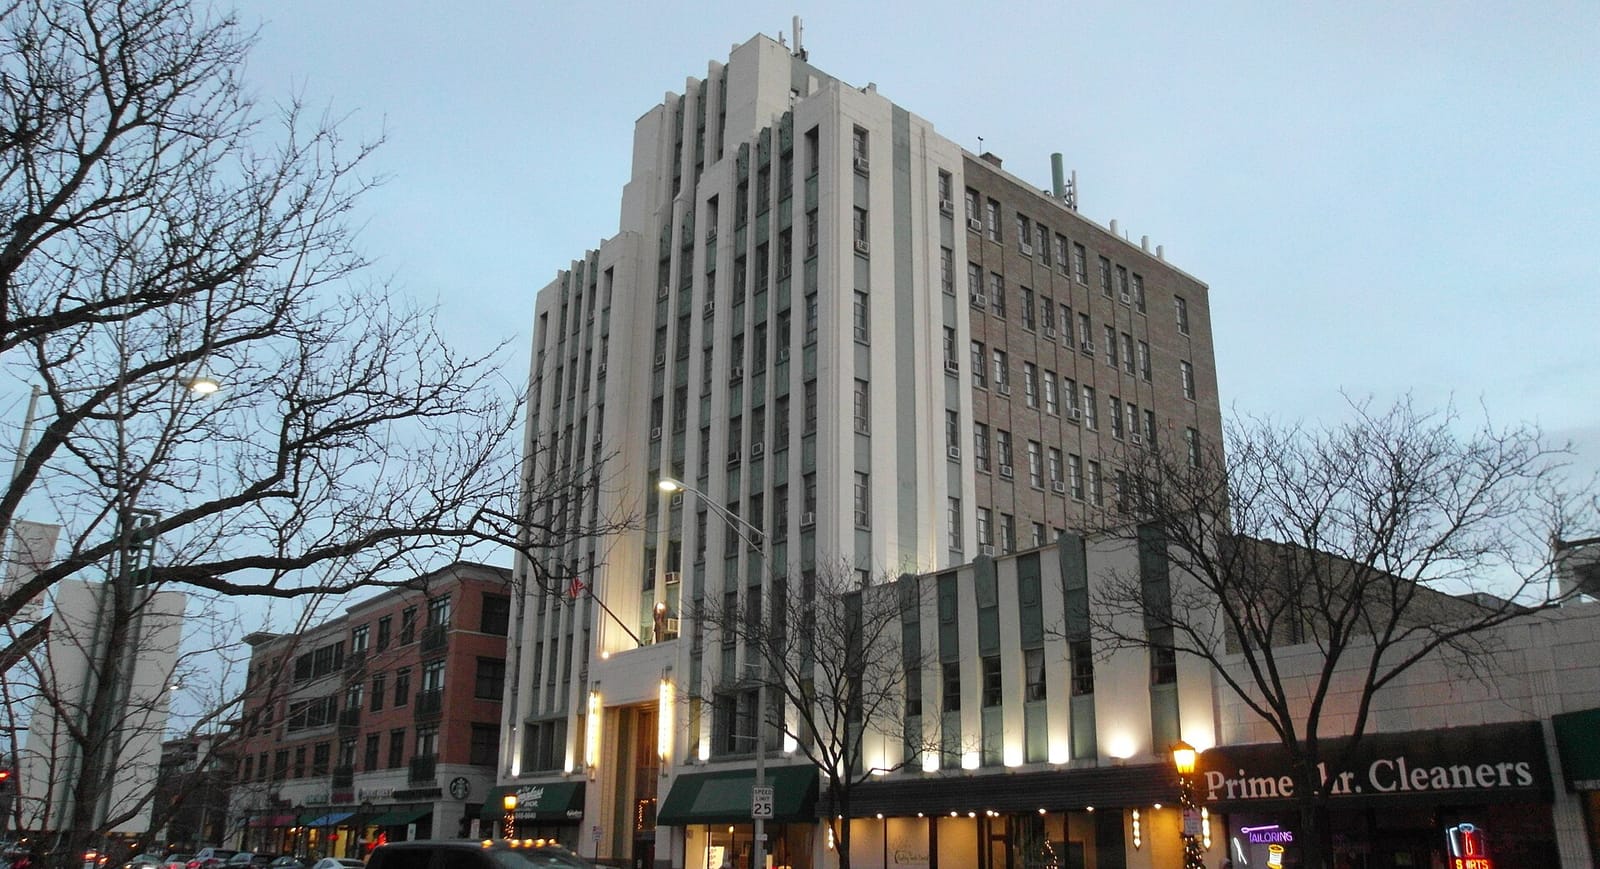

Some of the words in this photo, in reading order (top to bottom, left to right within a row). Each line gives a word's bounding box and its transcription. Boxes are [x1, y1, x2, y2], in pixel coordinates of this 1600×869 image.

[1204, 768, 1294, 800] Prime
[1368, 756, 1533, 793] Cleaners
[754, 803, 772, 815] 25
[1455, 859, 1489, 869] SIRTS
